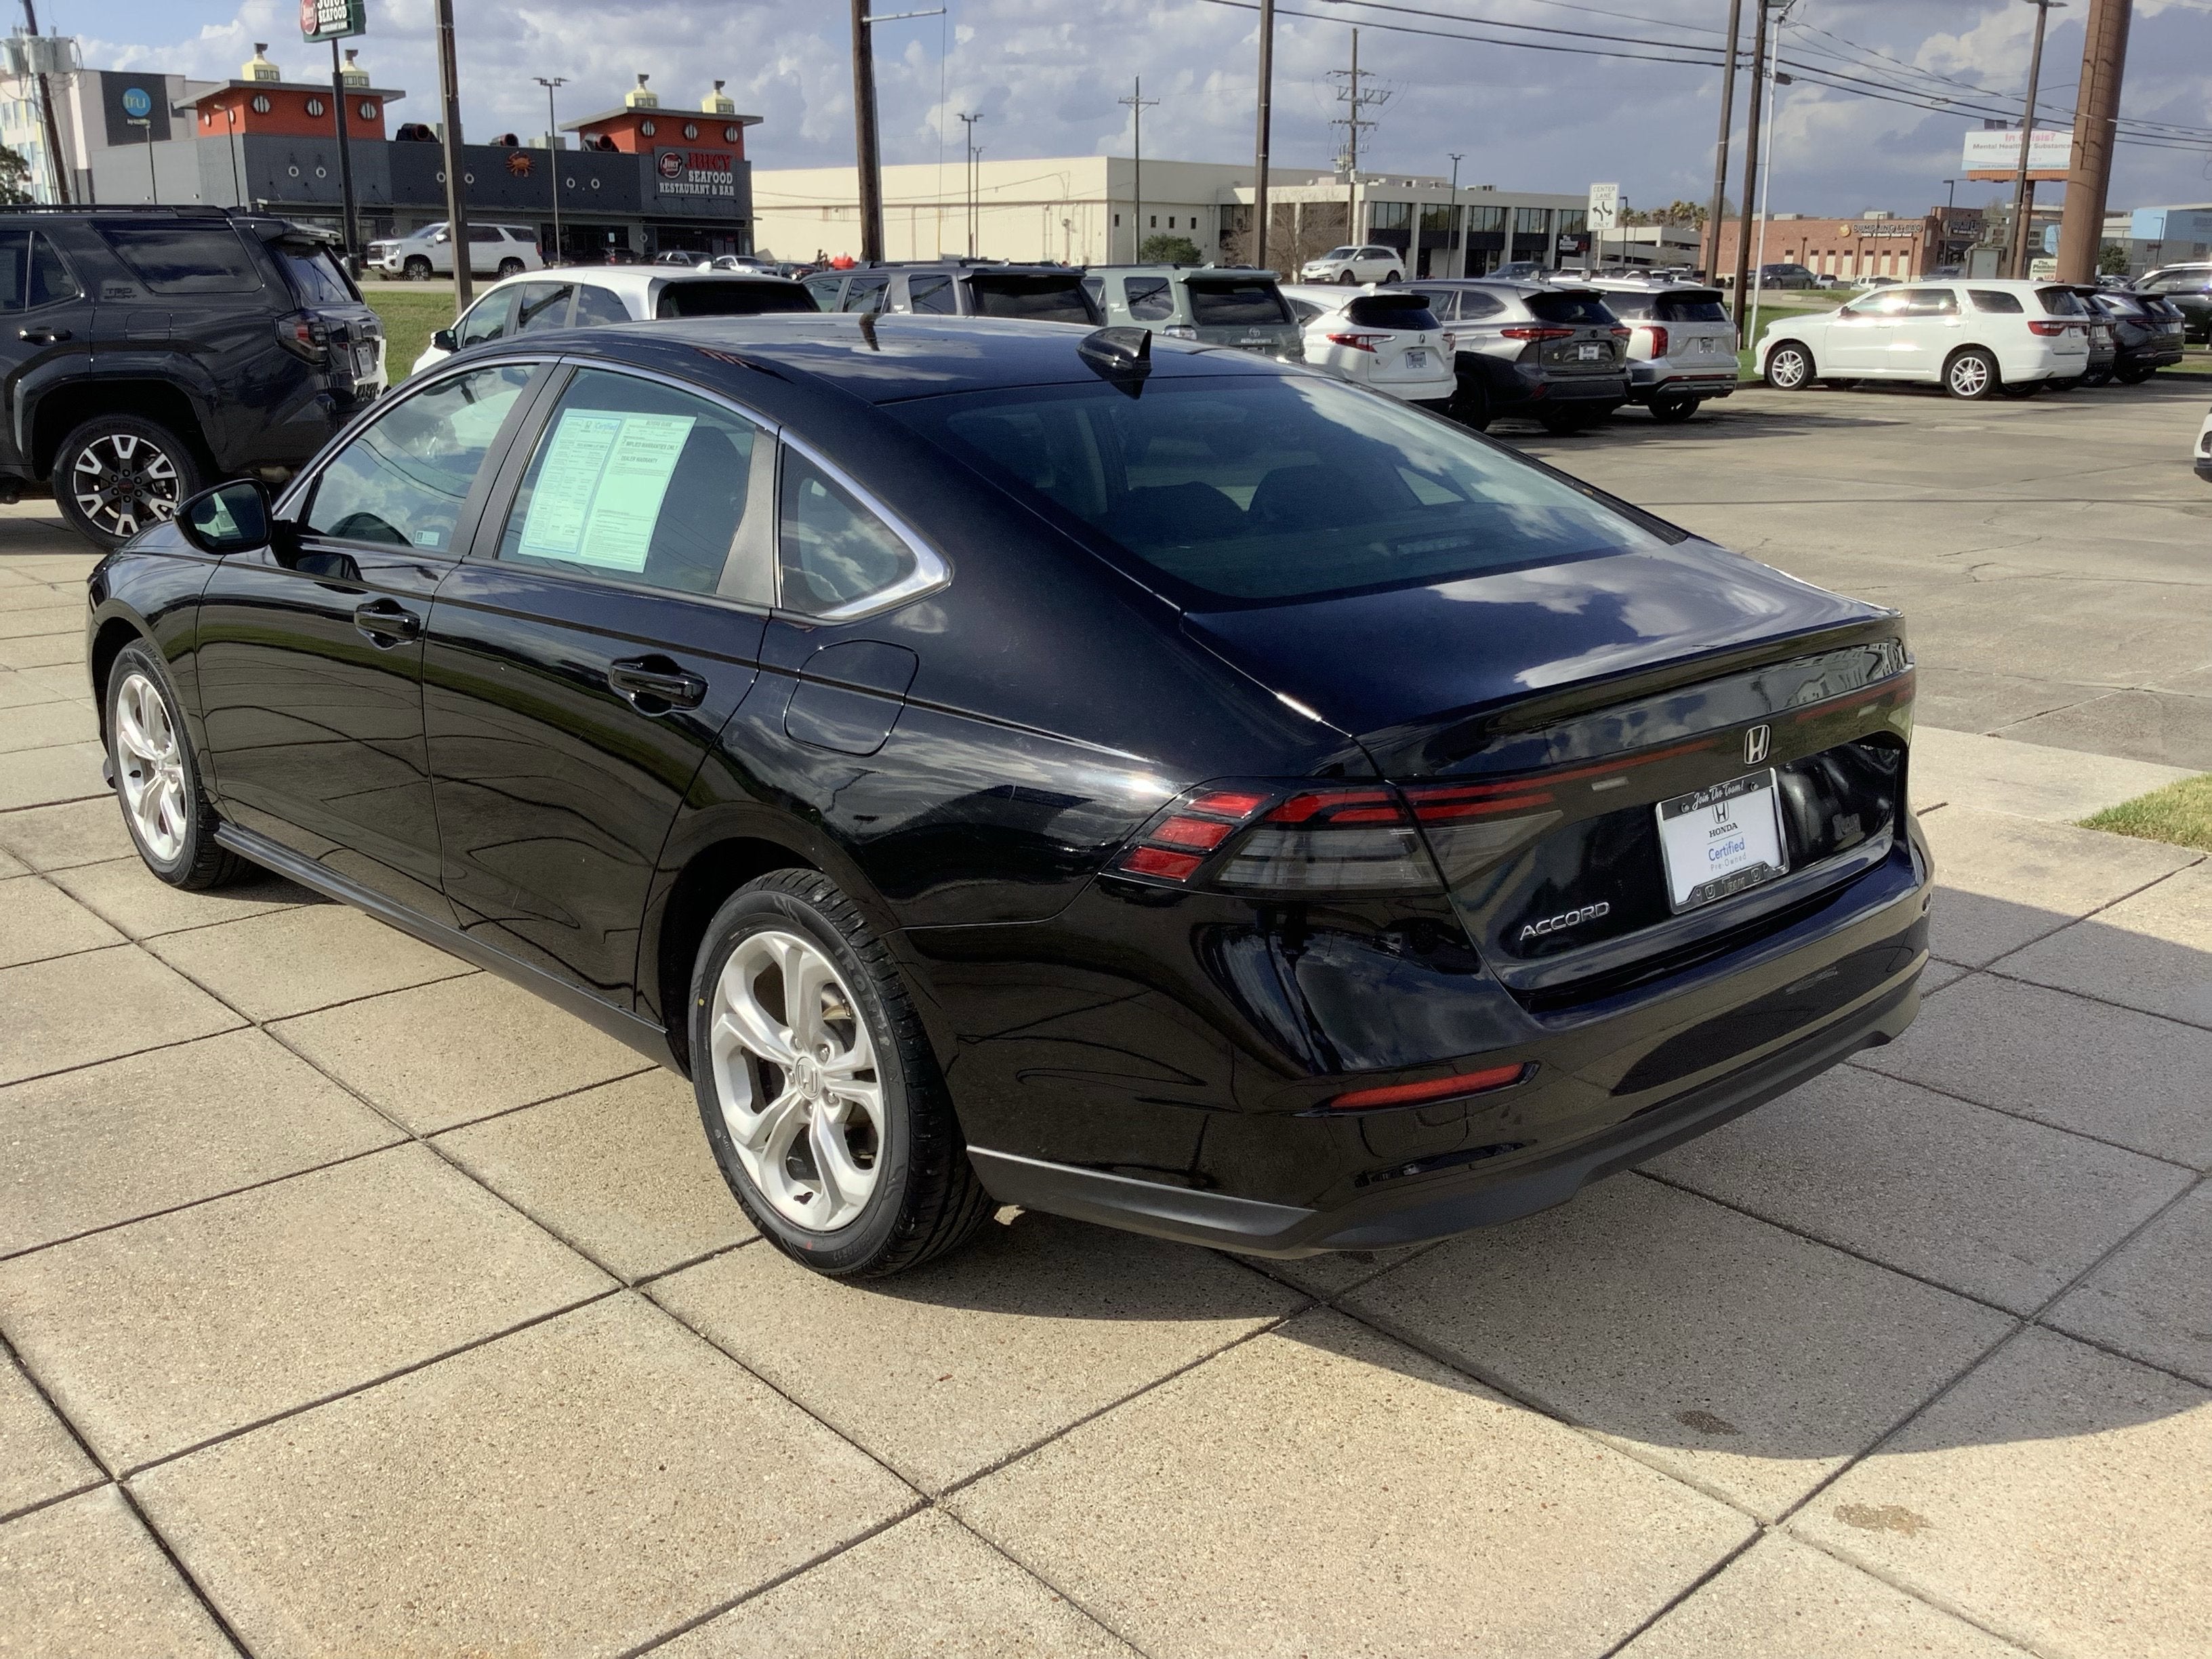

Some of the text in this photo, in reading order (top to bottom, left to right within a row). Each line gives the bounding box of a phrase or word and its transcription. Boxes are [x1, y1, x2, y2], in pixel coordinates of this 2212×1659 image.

[318, 5, 347, 23] SEAFOOD
[2005, 134, 2056, 142] In Cisis?
[685, 152, 732, 171] JUICY
[689, 171, 733, 184] SEAFOOD
[659, 182, 734, 196] RESTAURANT & BAR
[1692, 791, 1710, 811] Join
[1708, 822, 1738, 838] HONDA
[1708, 838, 1745, 861] Certified
[1519, 901, 1610, 941] ACCORD
